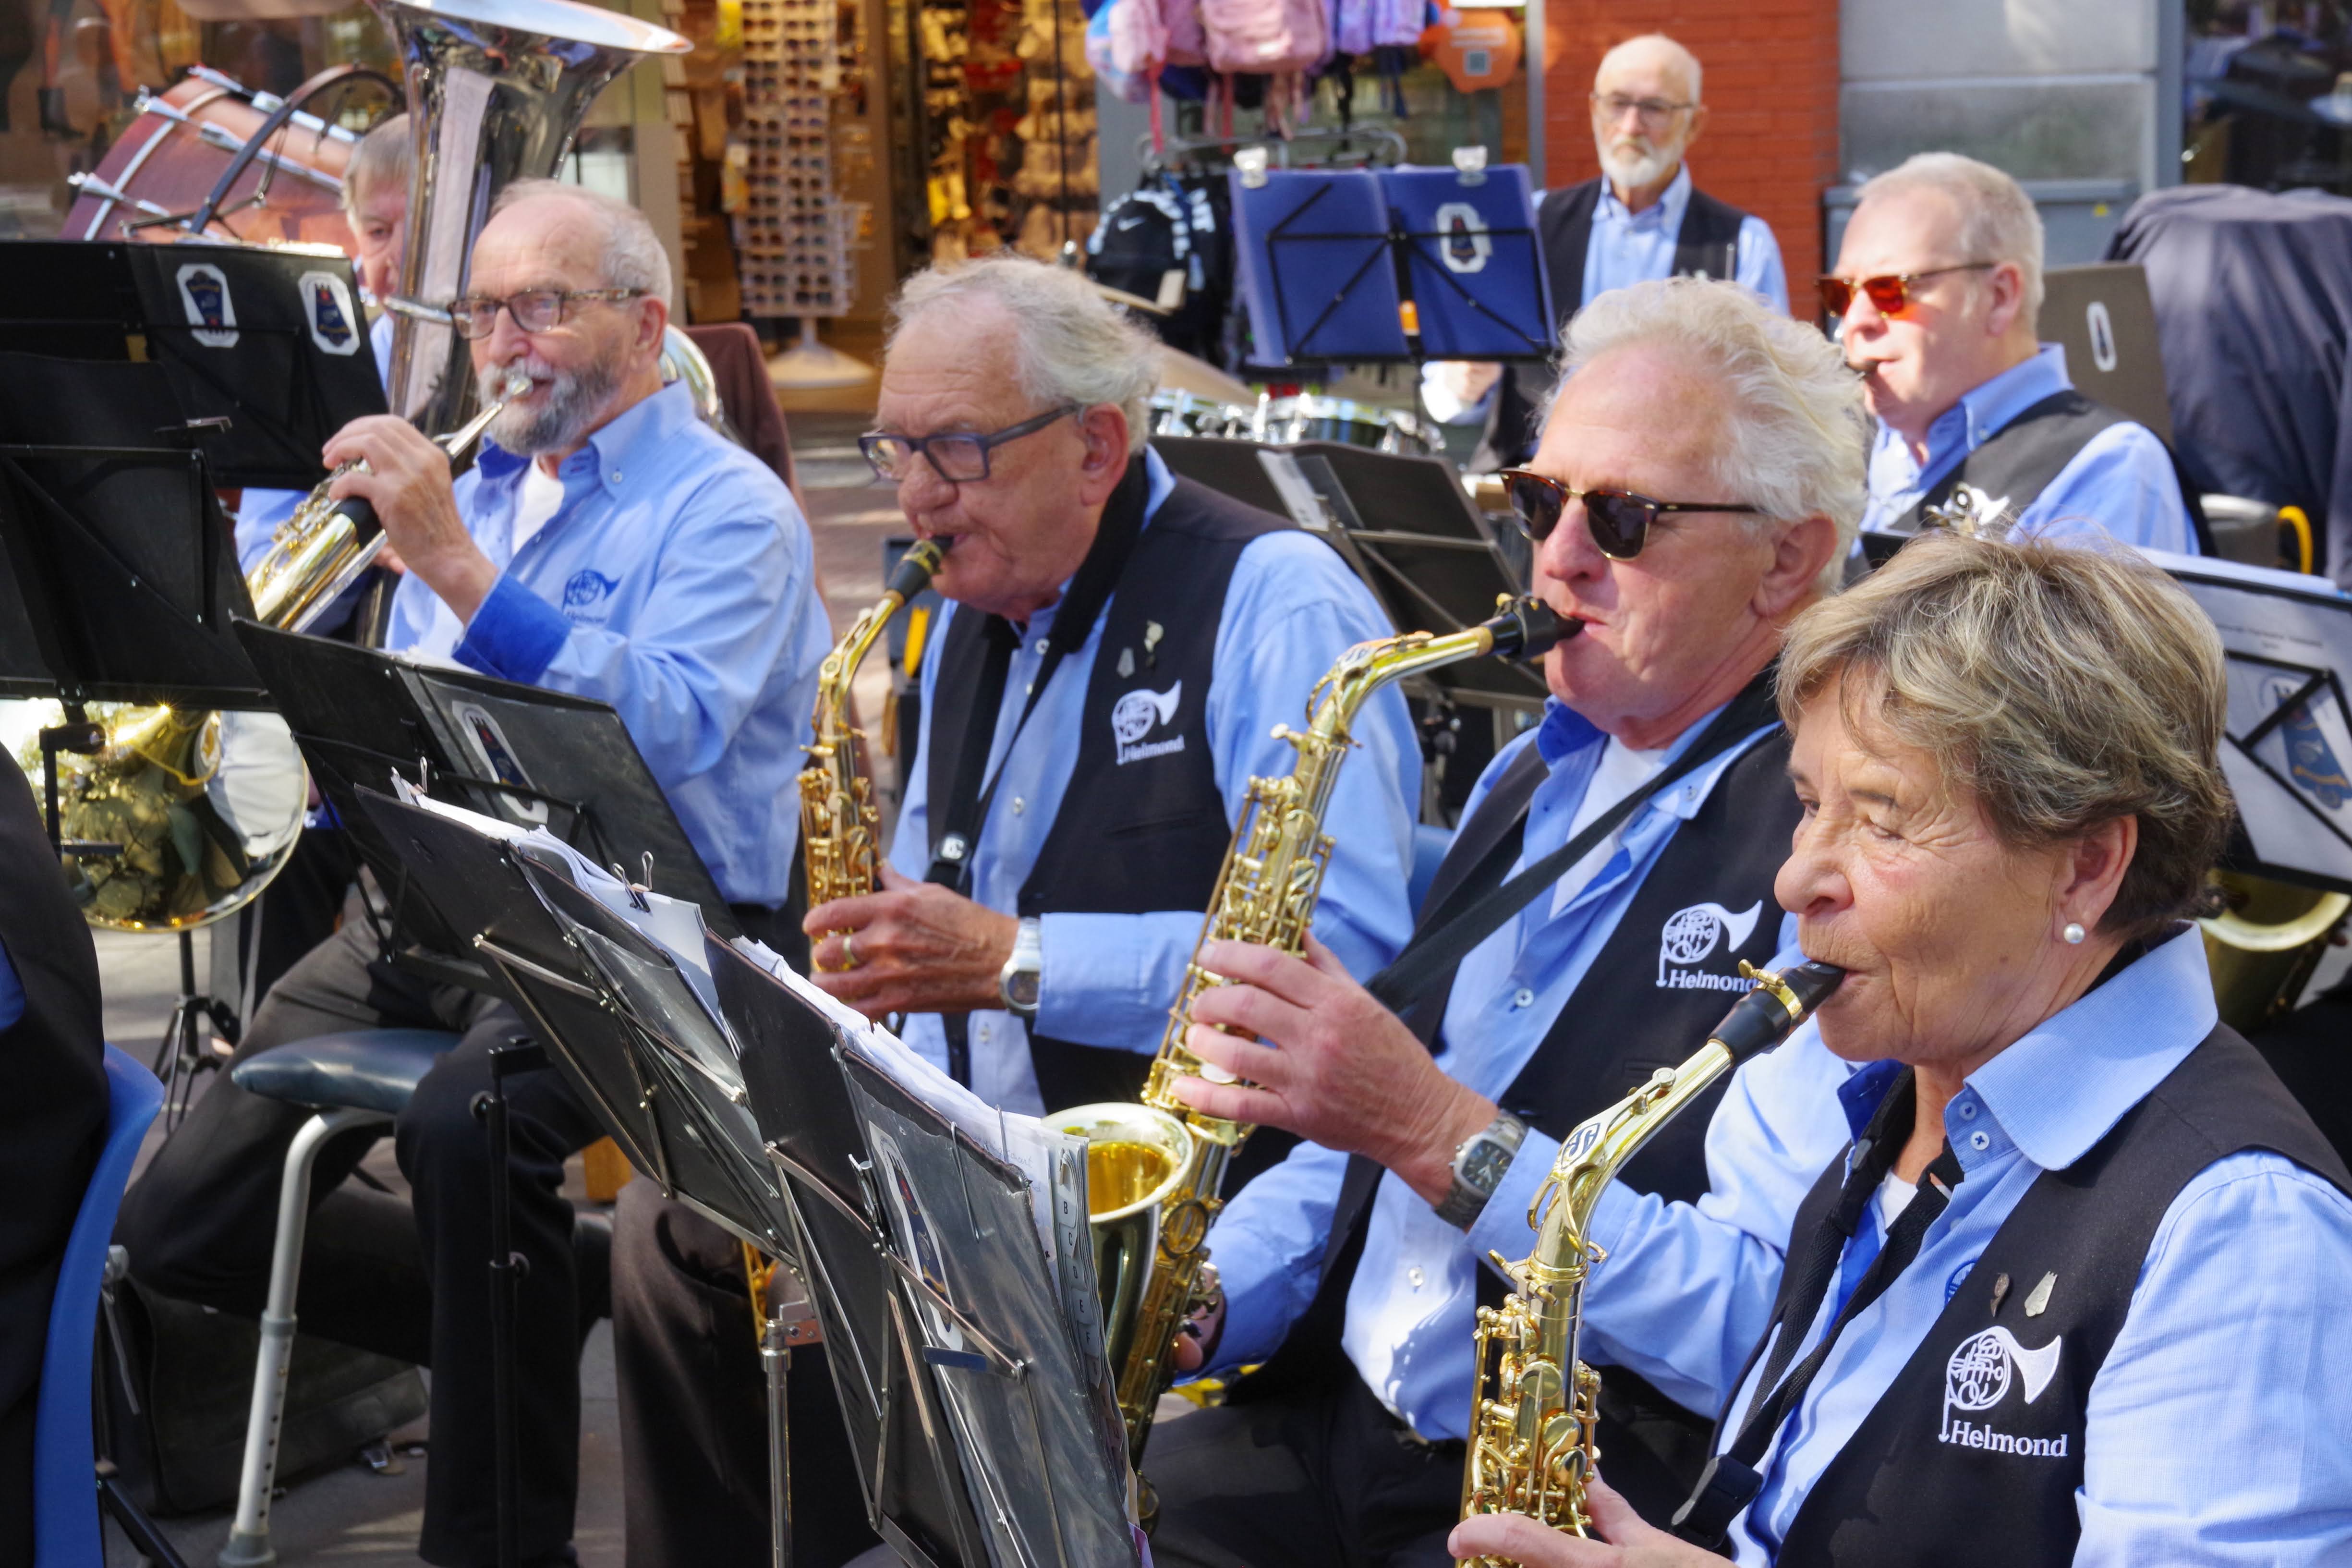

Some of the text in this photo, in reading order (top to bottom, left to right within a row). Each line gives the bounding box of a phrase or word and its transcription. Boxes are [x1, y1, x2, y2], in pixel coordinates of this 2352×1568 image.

[1063, 1201, 1068, 1215] B
[1068, 1232, 1073, 1246] C
[1079, 1299, 1084, 1313] E
[1086, 1331, 1091, 1343] F
[1950, 1420, 2068, 1457] Helmond
